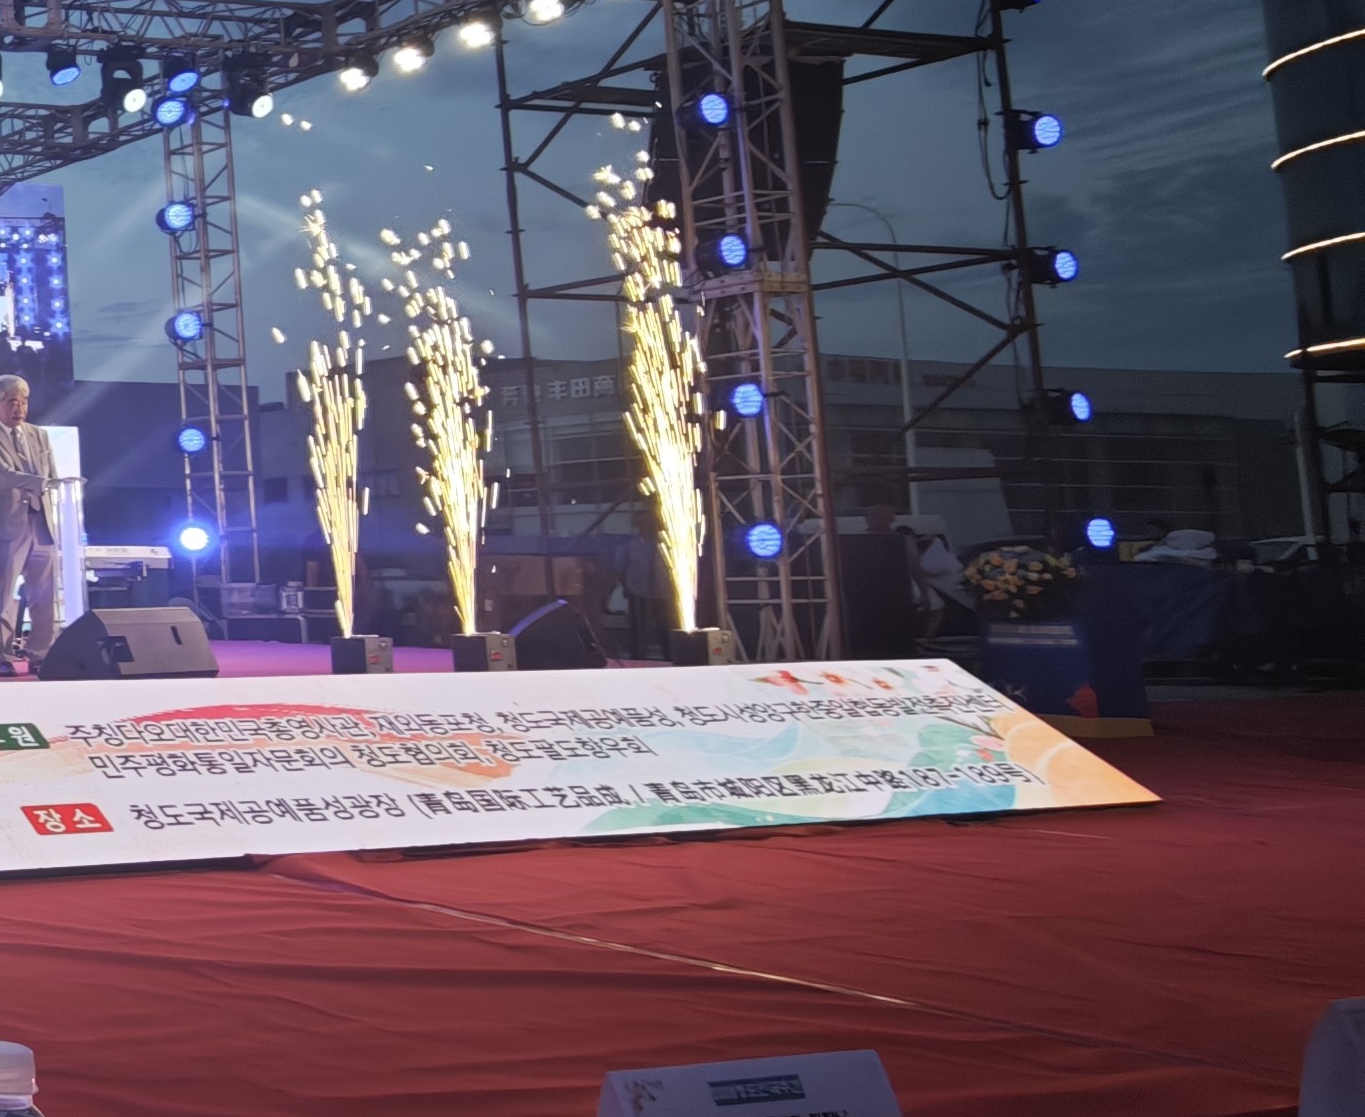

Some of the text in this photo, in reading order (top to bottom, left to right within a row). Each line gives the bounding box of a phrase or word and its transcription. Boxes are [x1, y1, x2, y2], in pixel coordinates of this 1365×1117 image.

[68, 715, 376, 746] 주칭다오대한민국총영사관,
[368, 712, 502, 737] 재외동포청,
[494, 707, 683, 733] 청도국제공예품성,
[90, 735, 658, 778] 민주평화통일자문회의 청도협의회, 청도팔도향우회
[129, 793, 406, 830] 청도국제공예품성광장
